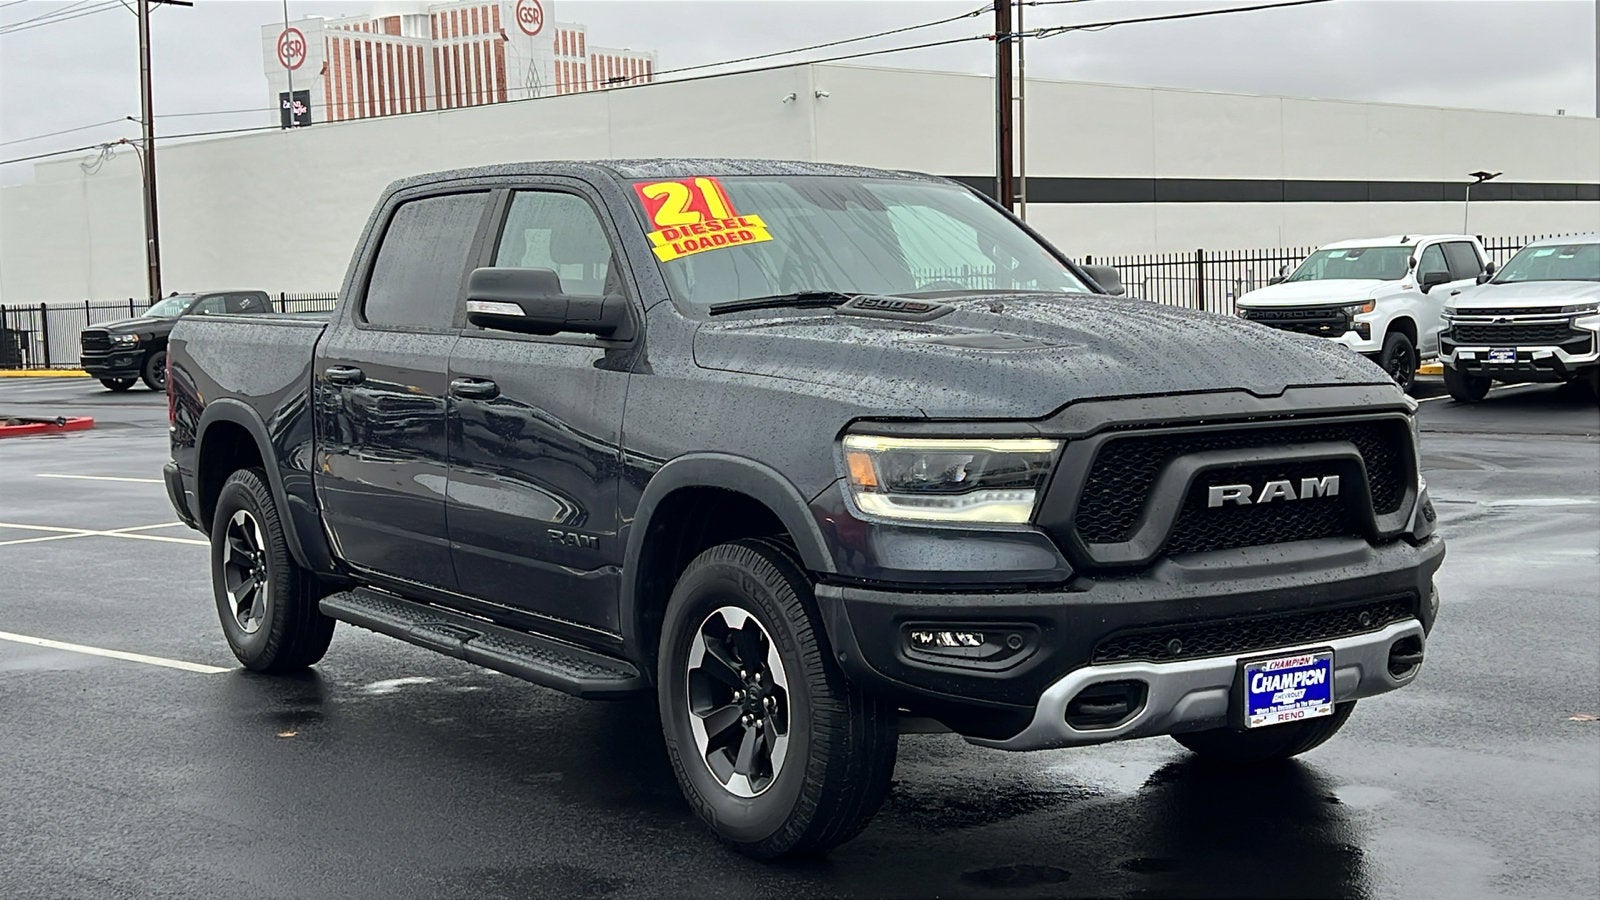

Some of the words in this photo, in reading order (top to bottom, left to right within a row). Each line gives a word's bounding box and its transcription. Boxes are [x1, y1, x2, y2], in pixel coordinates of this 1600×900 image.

[520, 7, 540, 24] GSR
[281, 40, 302, 57] GSR
[642, 177, 730, 226] 21
[662, 217, 754, 241] DIESEL
[672, 230, 754, 254] LOADED
[858, 298, 906, 309] 1500
[1208, 475, 1340, 508] RAM
[547, 529, 600, 550] RAM
[1269, 657, 1311, 669] CHAMPION
[1251, 668, 1327, 694] CHAMPION
[1278, 711, 1305, 721] RENO
